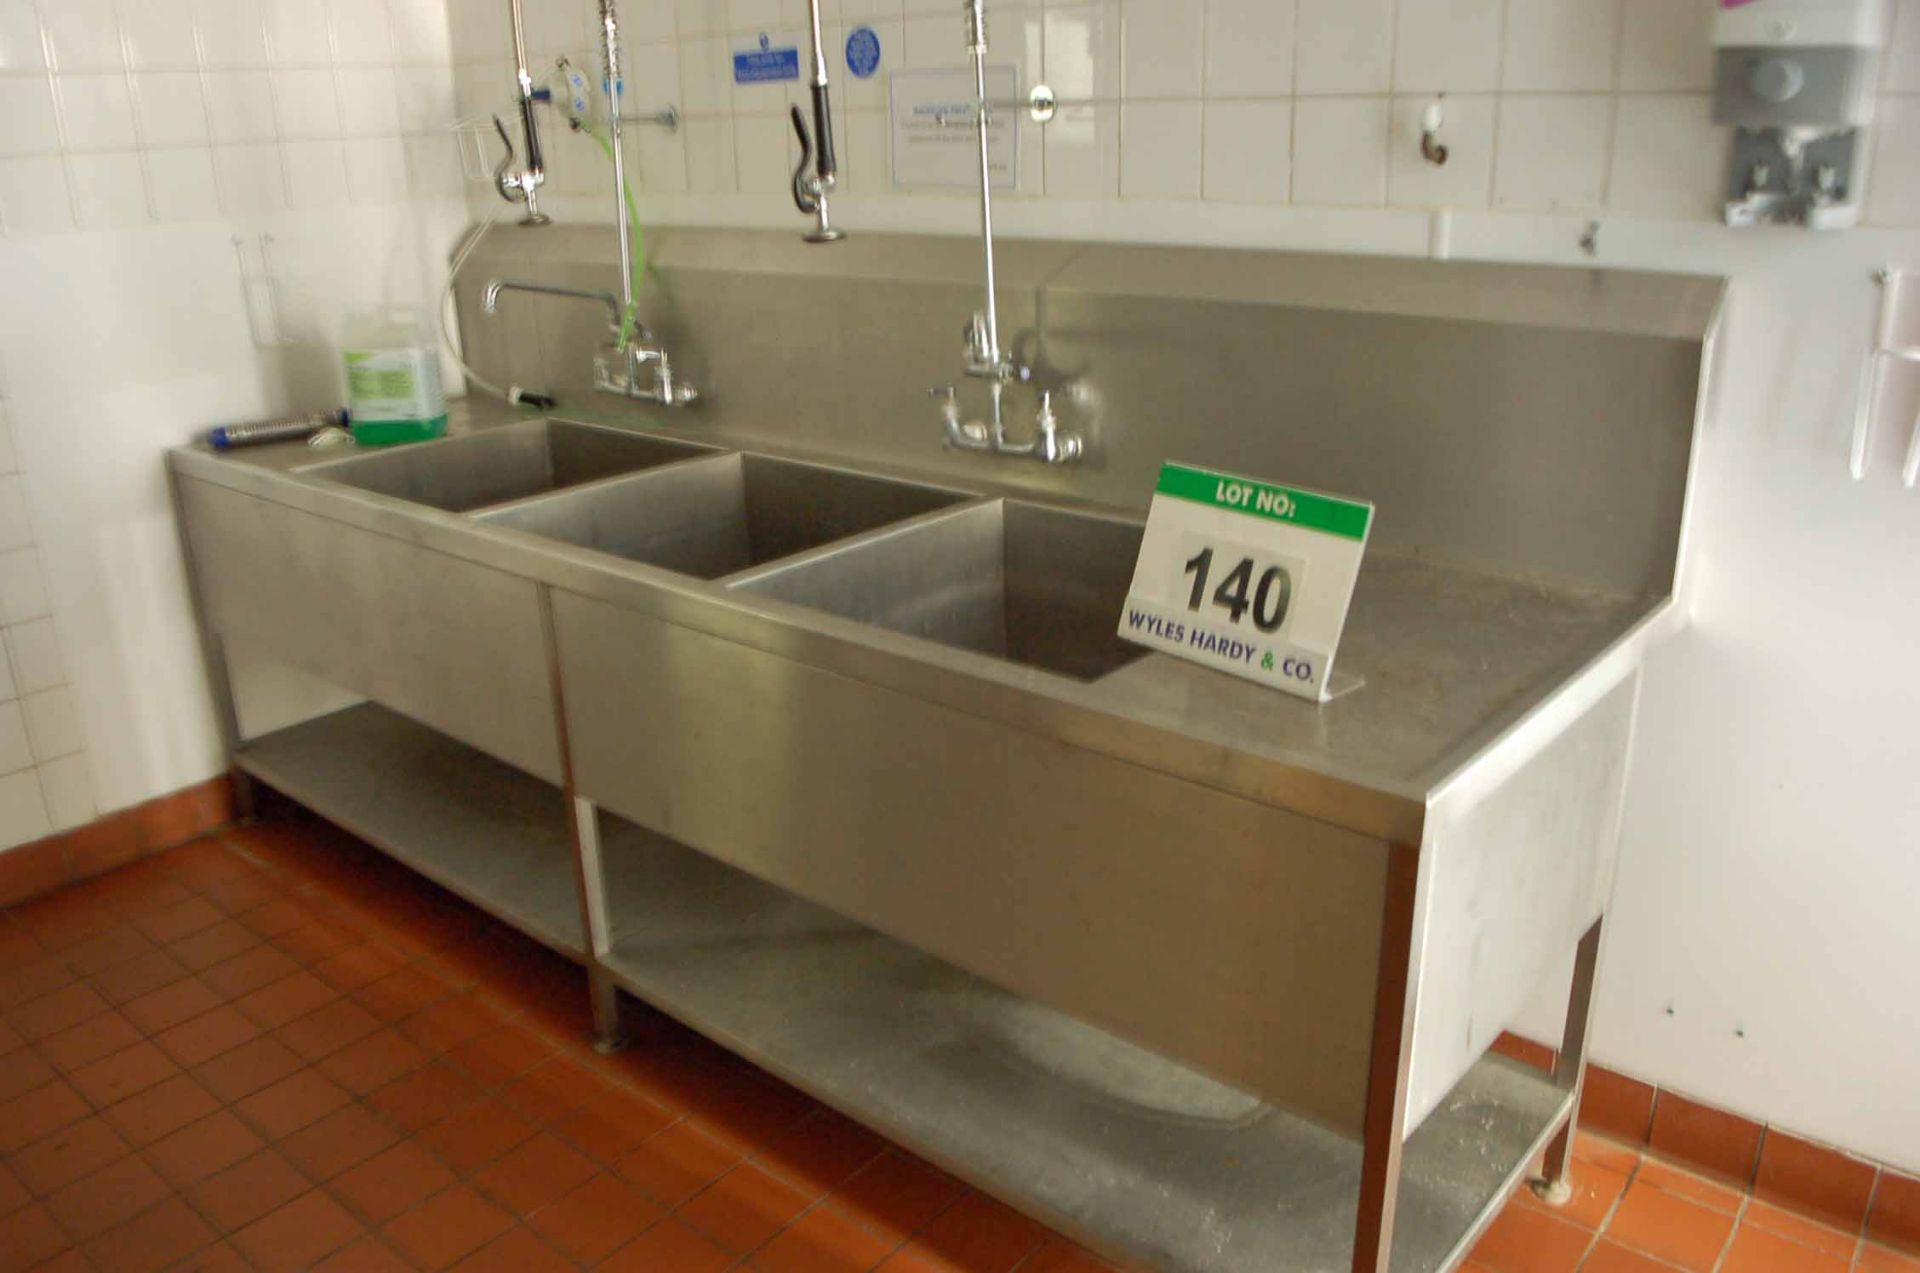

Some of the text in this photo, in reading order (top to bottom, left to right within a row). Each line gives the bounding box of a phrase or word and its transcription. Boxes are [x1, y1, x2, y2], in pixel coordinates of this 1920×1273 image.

[1216, 481, 1296, 517] LOT NO:
[1185, 547, 1292, 635] 140
[1128, 610, 1314, 684] WYLES HARDY & CO.
